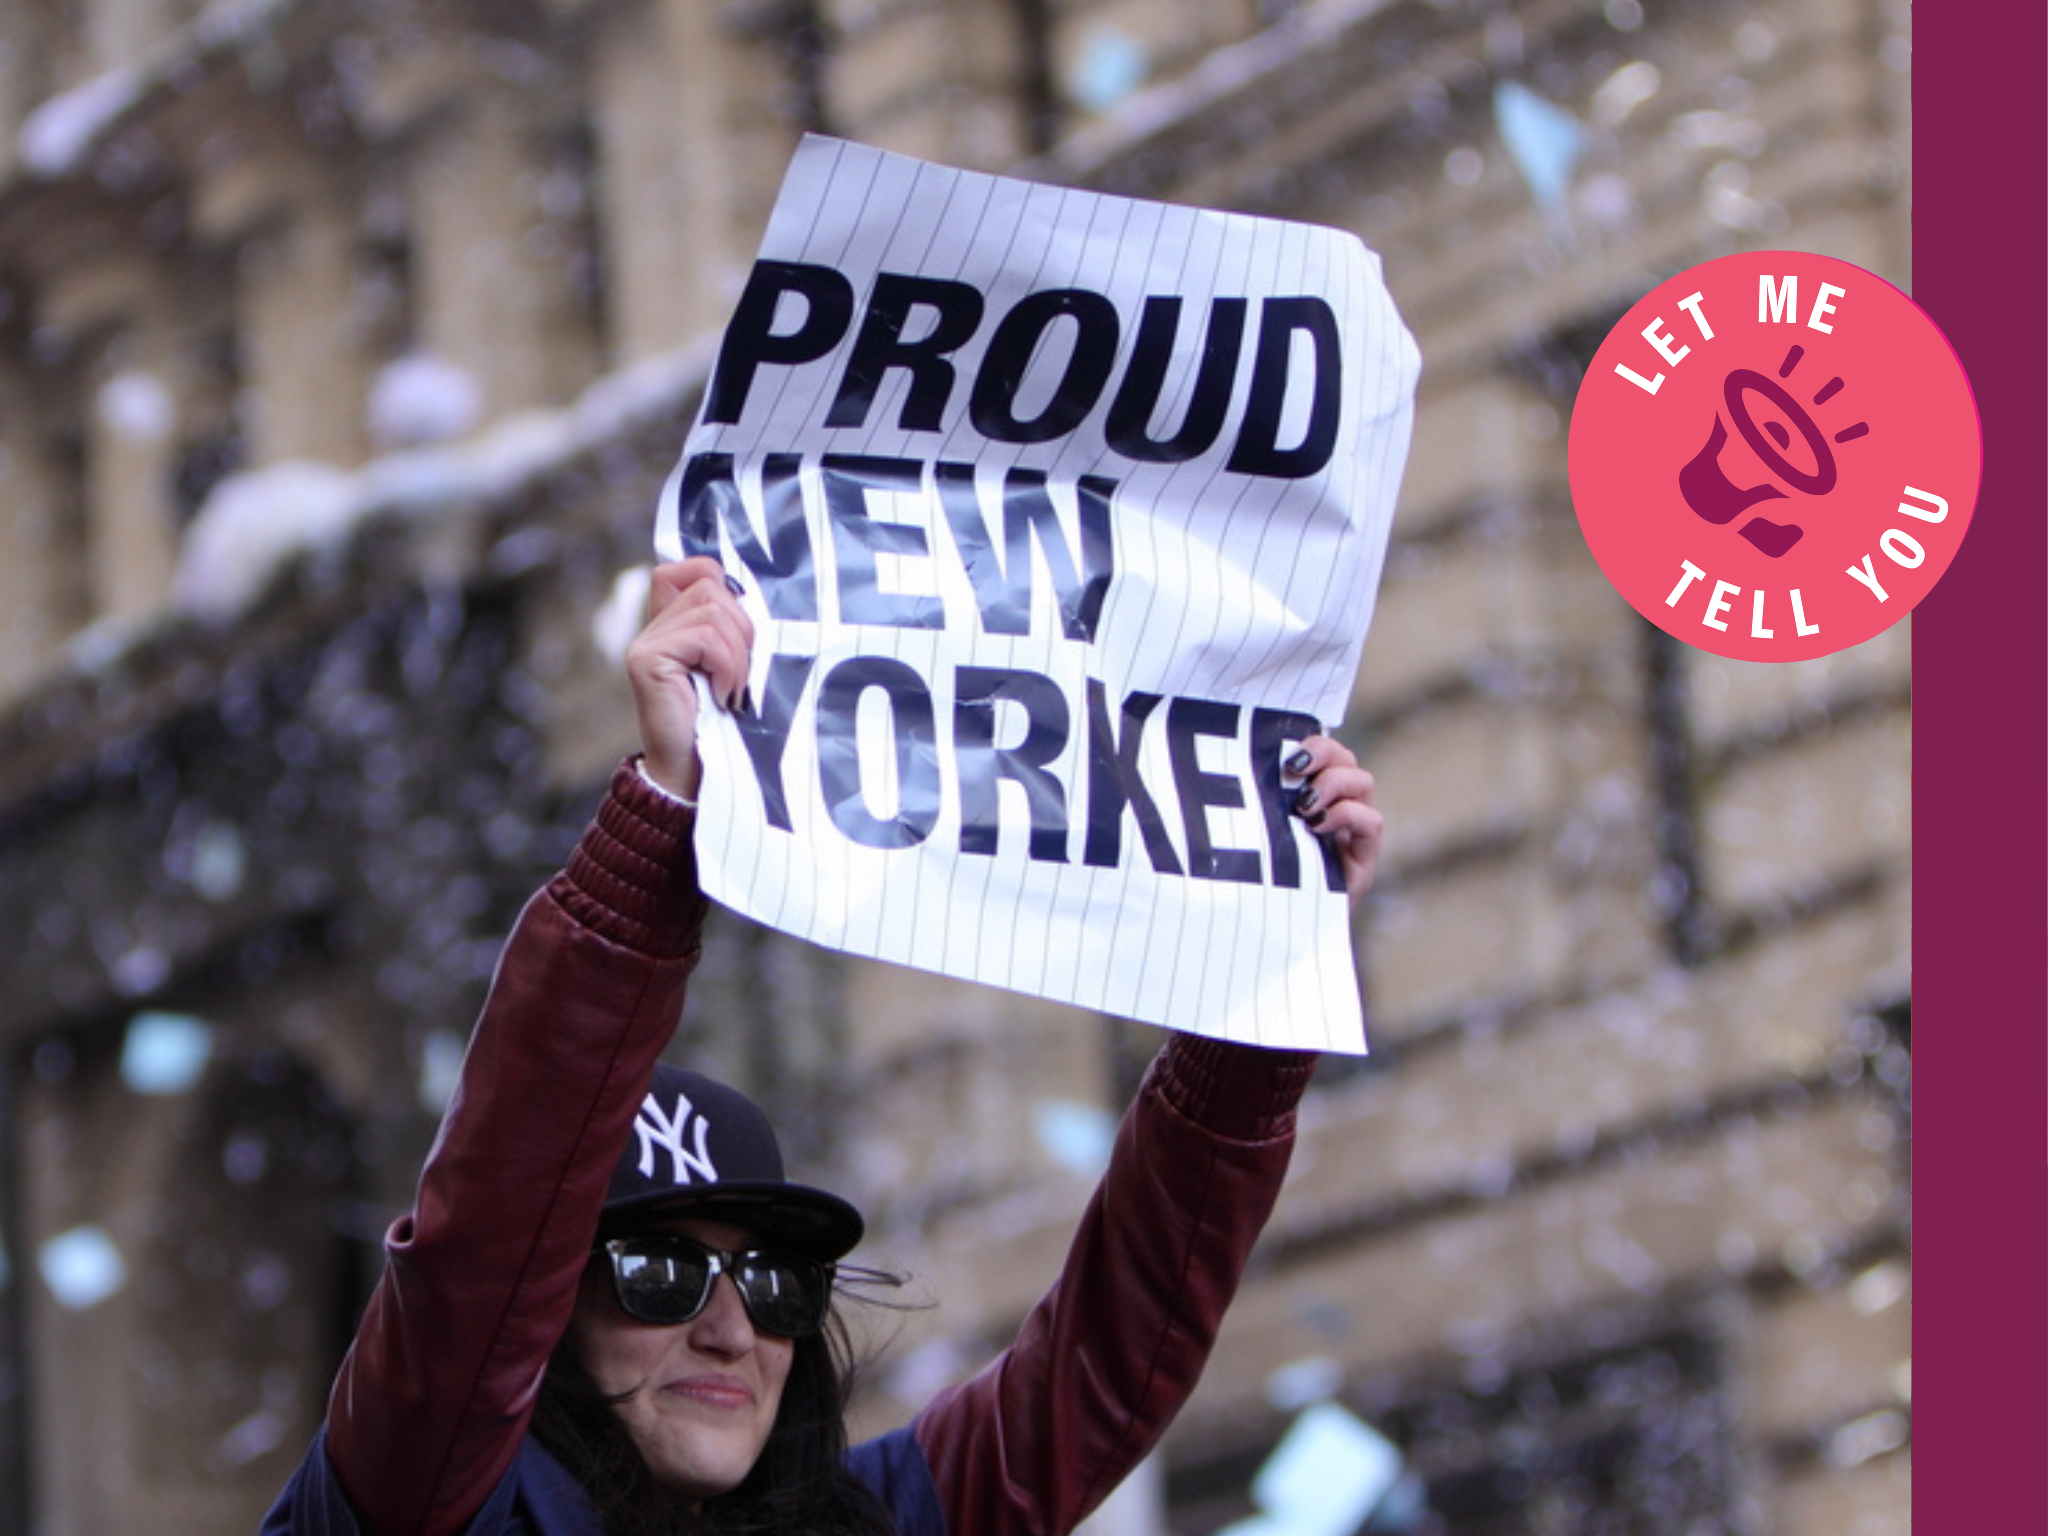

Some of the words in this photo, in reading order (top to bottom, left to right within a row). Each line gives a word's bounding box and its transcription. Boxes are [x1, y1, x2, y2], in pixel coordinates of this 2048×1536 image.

[701, 258, 1342, 479] PROUD
[678, 452, 1121, 645] NEW
[730, 654, 1348, 894] YORKER
[633, 1092, 719, 1185] NY
